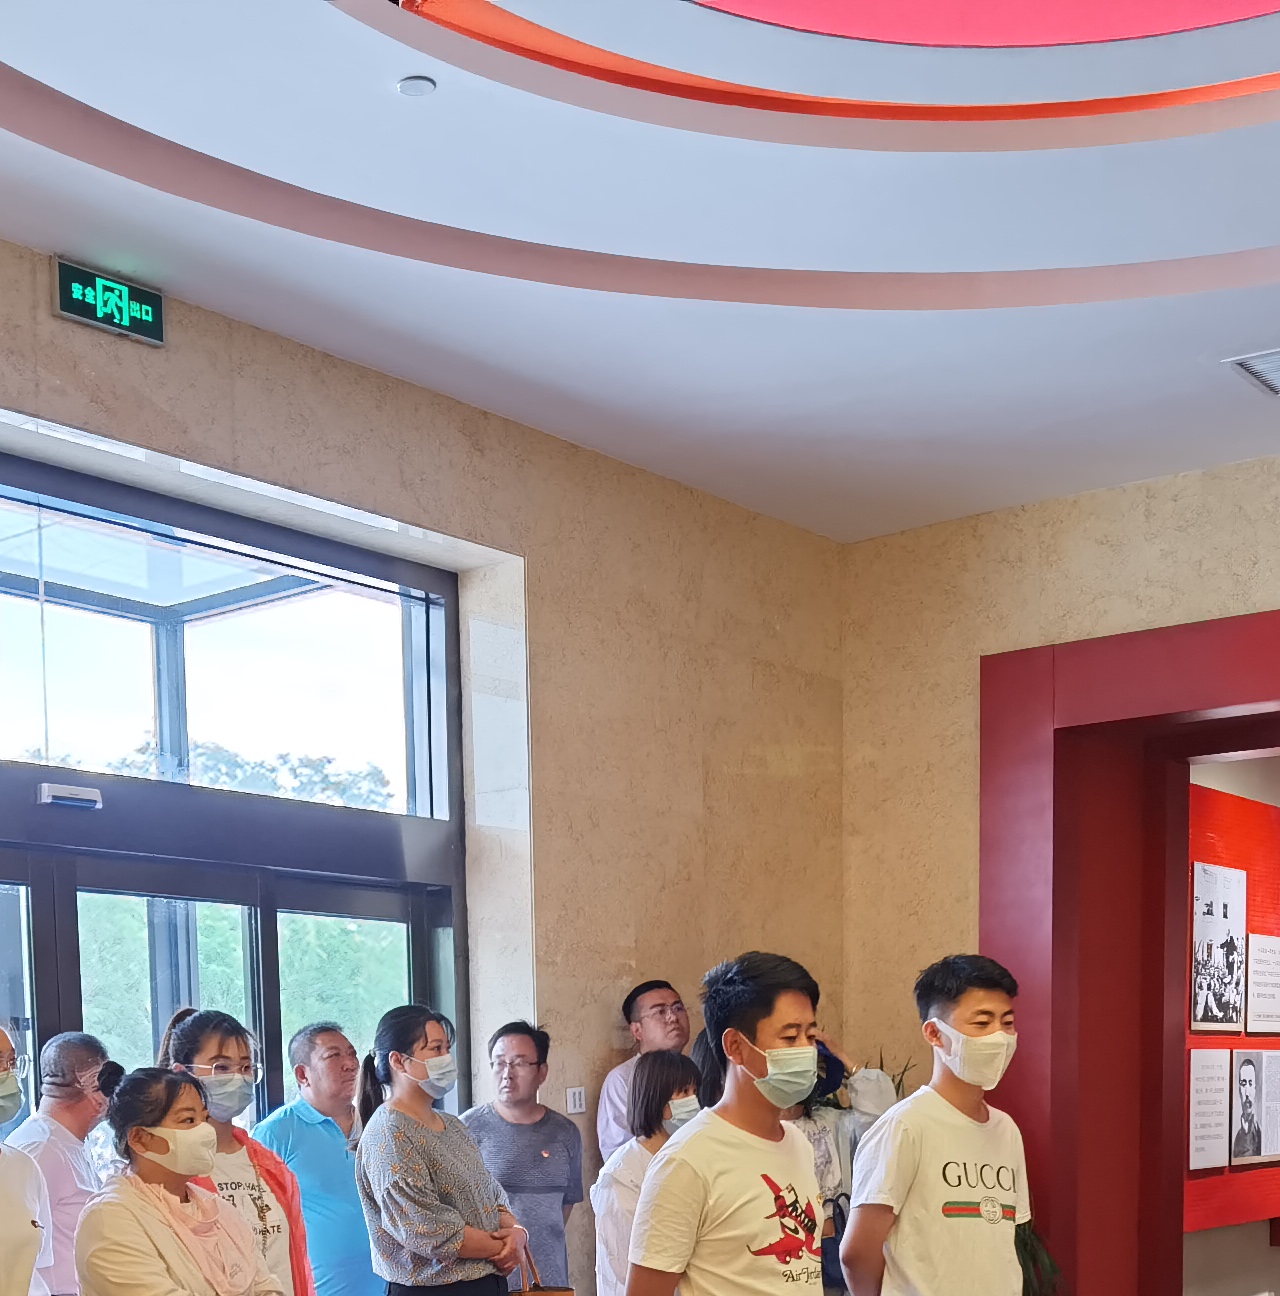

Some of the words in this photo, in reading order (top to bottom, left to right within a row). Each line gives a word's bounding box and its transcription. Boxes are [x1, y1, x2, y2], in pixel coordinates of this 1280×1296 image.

[71, 282, 96, 305] 安全
[129, 300, 153, 322] 出口
[217, 1181, 243, 1192] STOP
[942, 1161, 1016, 1193] GUCCI
[782, 1269, 801, 1282] Air
